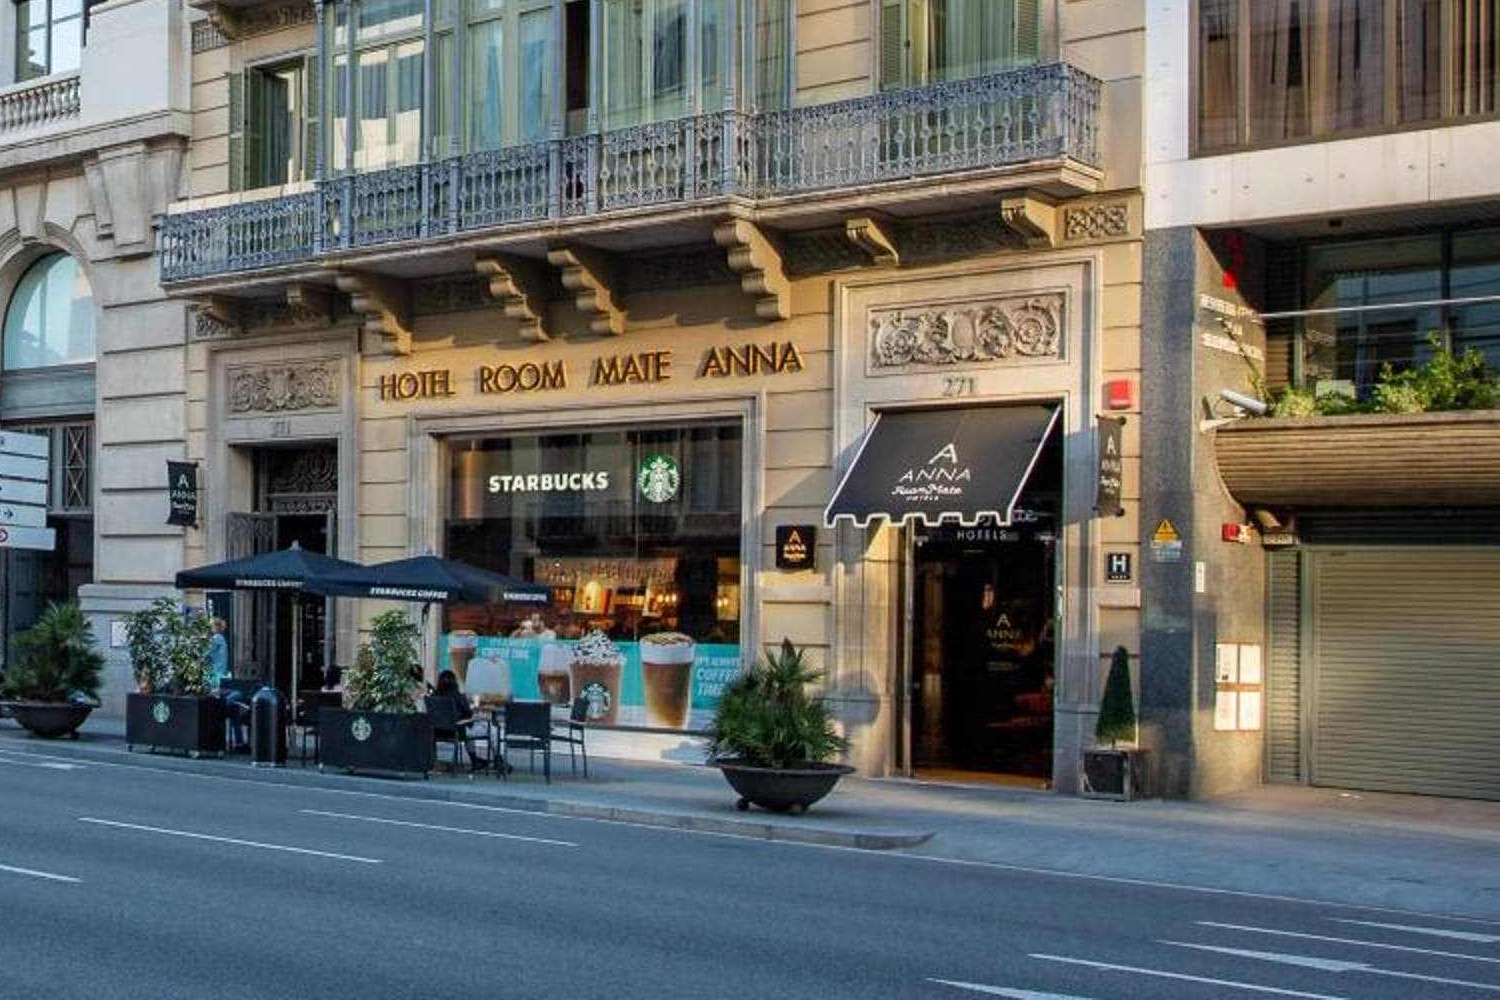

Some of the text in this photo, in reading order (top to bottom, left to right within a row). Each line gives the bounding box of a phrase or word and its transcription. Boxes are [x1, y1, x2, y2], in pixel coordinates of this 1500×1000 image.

[380, 342, 802, 400] HOTEL ROOM MATE ANNA
[941, 377, 976, 396] 271
[929, 442, 959, 464] A
[488, 471, 610, 493] STARBUCKS
[900, 467, 971, 483] ANNA
[957, 529, 1008, 542] HOTELS
[1112, 555, 1126, 572] H
